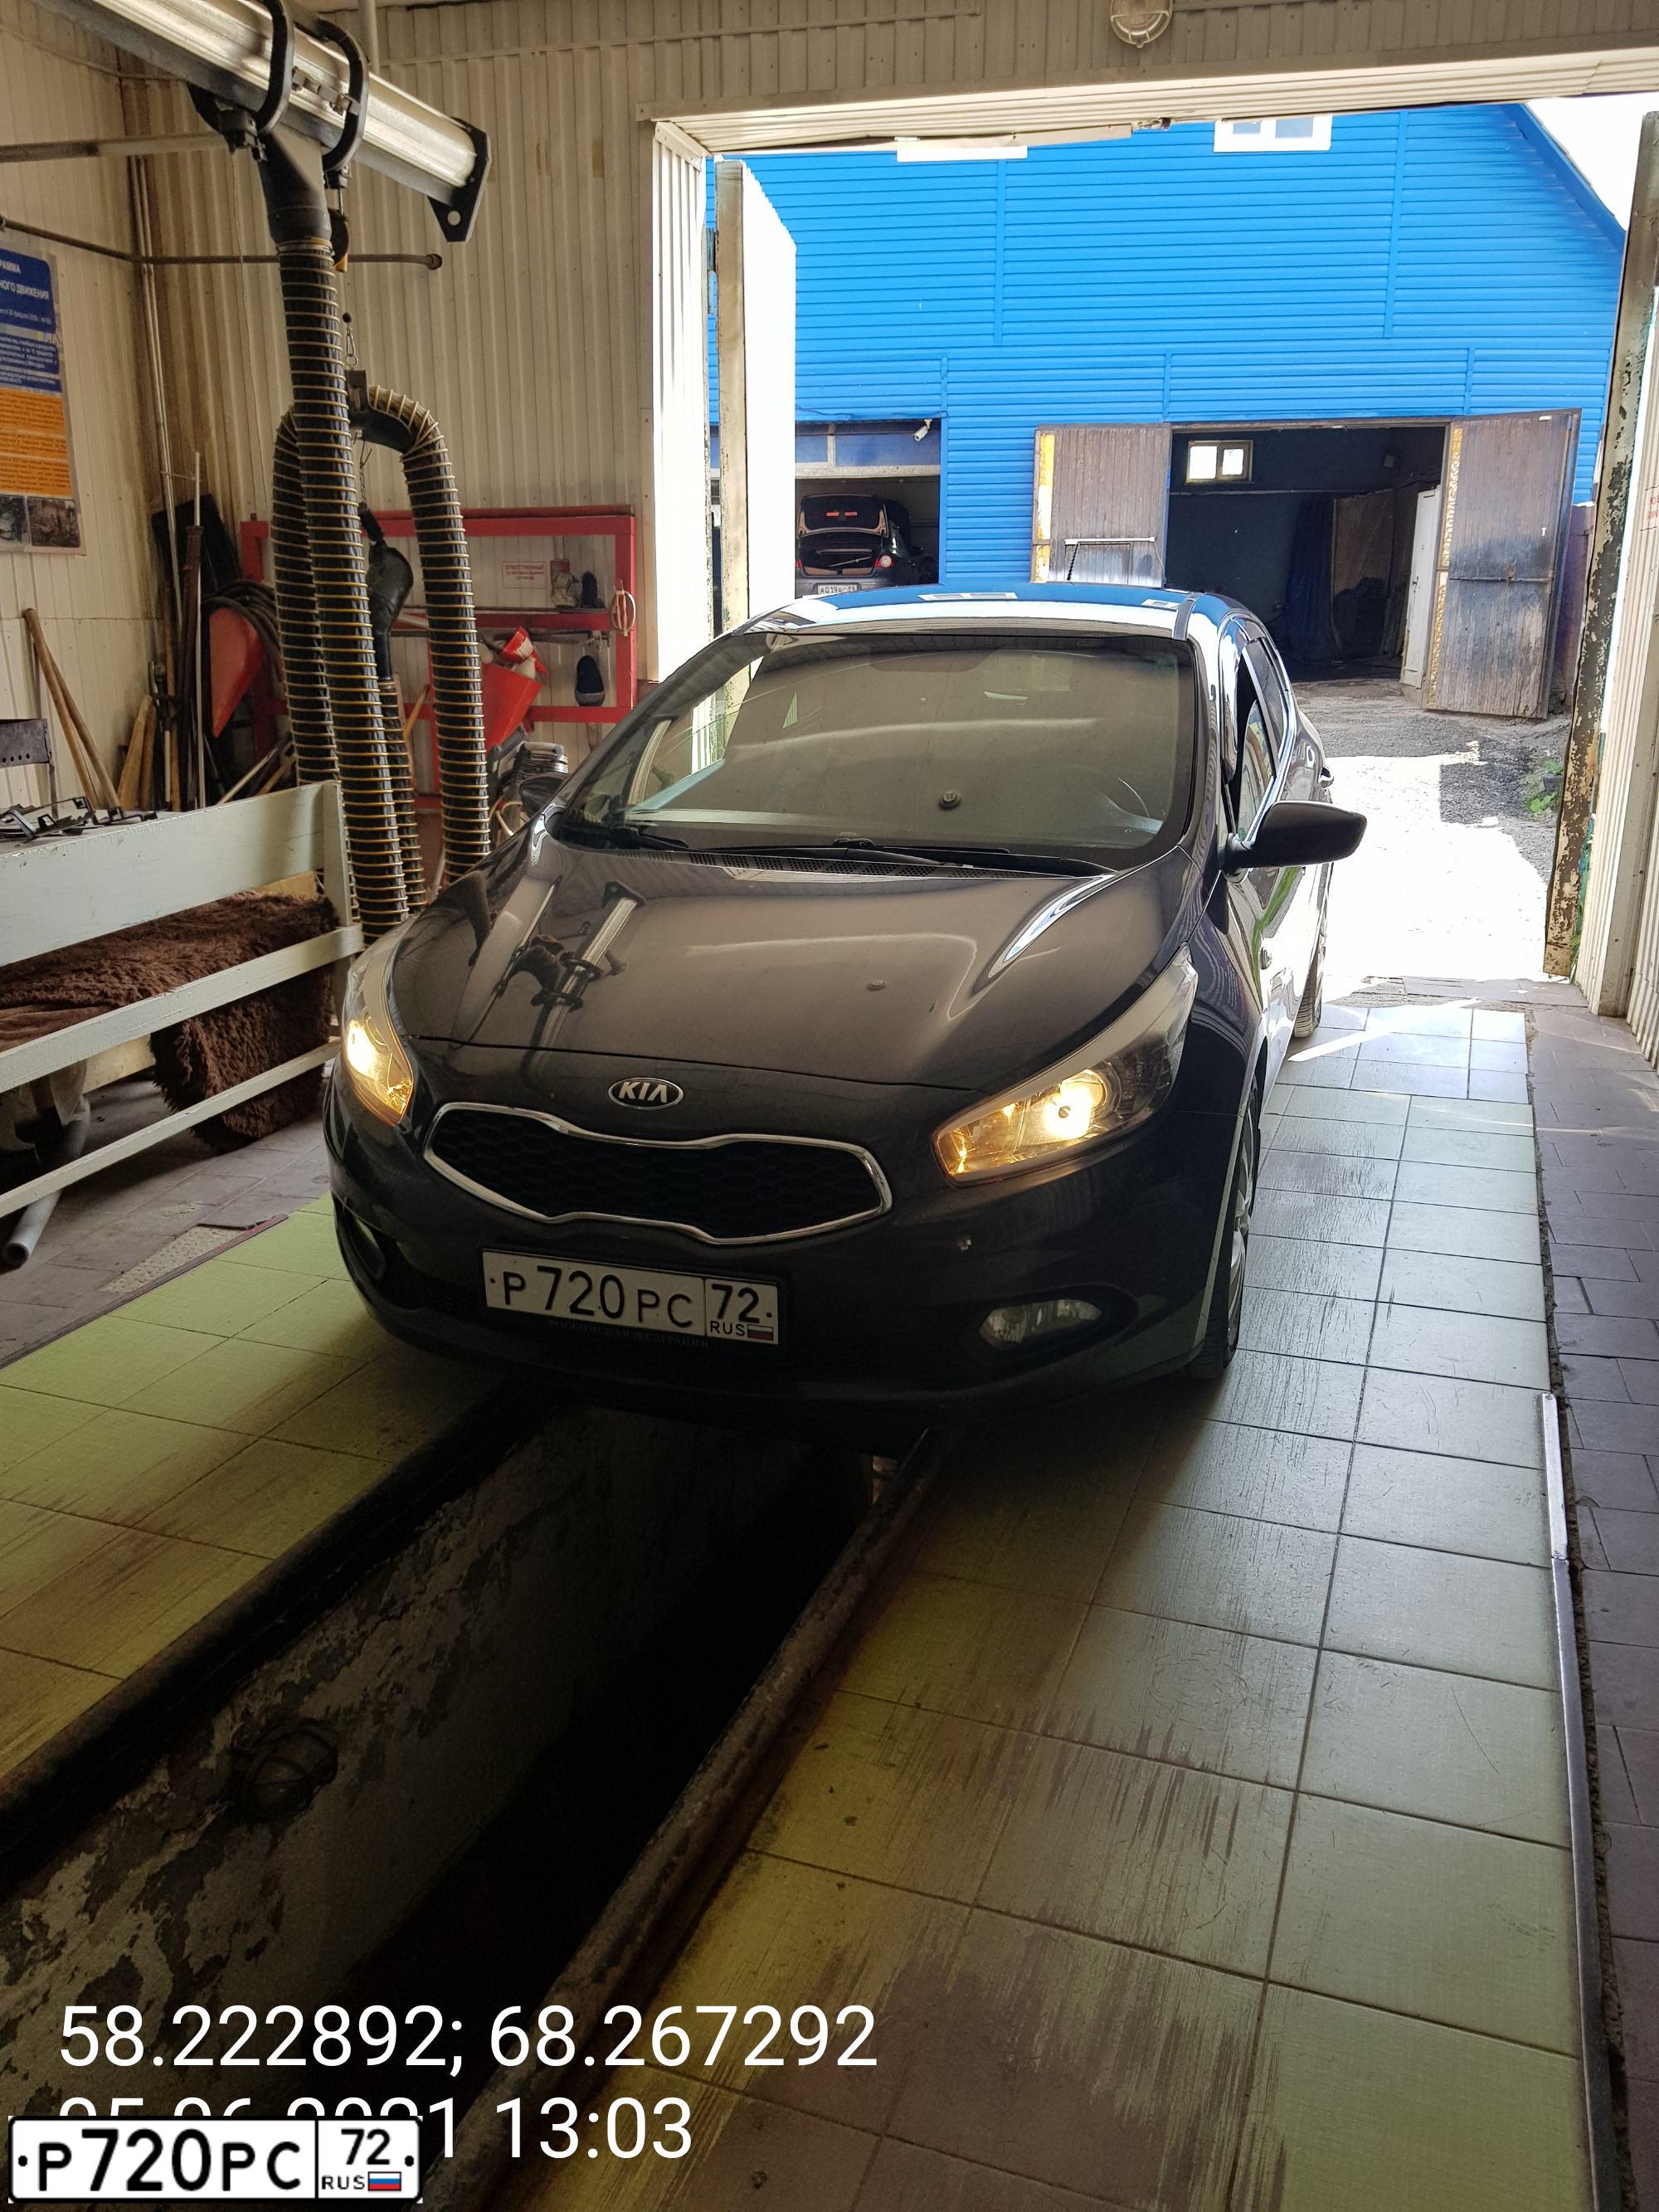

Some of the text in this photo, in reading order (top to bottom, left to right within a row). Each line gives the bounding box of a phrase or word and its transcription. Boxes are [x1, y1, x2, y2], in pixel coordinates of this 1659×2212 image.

[17, 284, 49, 300] ДВИЖЕНИЯ
[618, 1081, 668, 1104] KIA
[712, 1284, 760, 1324] 72
[710, 1321, 746, 1337] RUS
